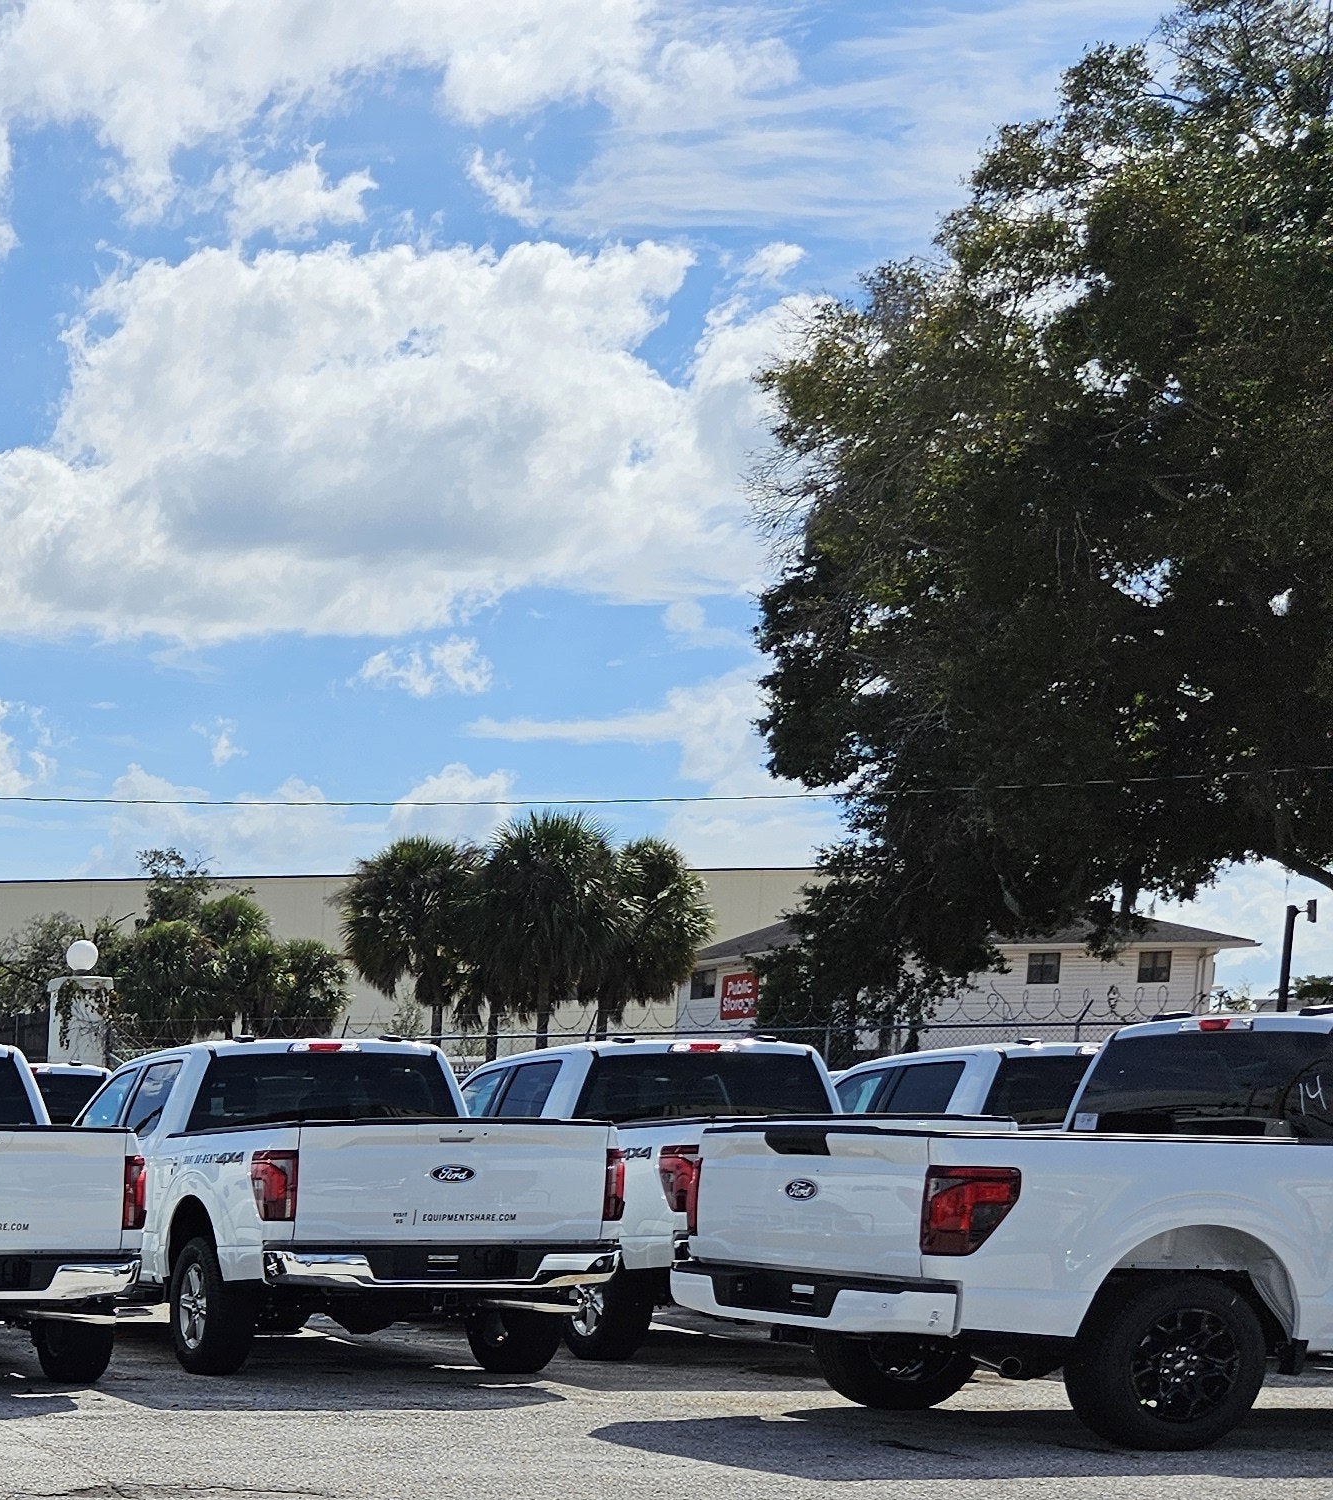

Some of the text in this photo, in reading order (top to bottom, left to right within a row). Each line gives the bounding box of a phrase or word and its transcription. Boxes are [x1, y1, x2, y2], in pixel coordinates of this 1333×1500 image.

[1298, 1075, 1328, 1117] 14
[438, 1167, 469, 1180] Ford
[422, 1213, 517, 1222] EQUIPMENTSHARE.COM
